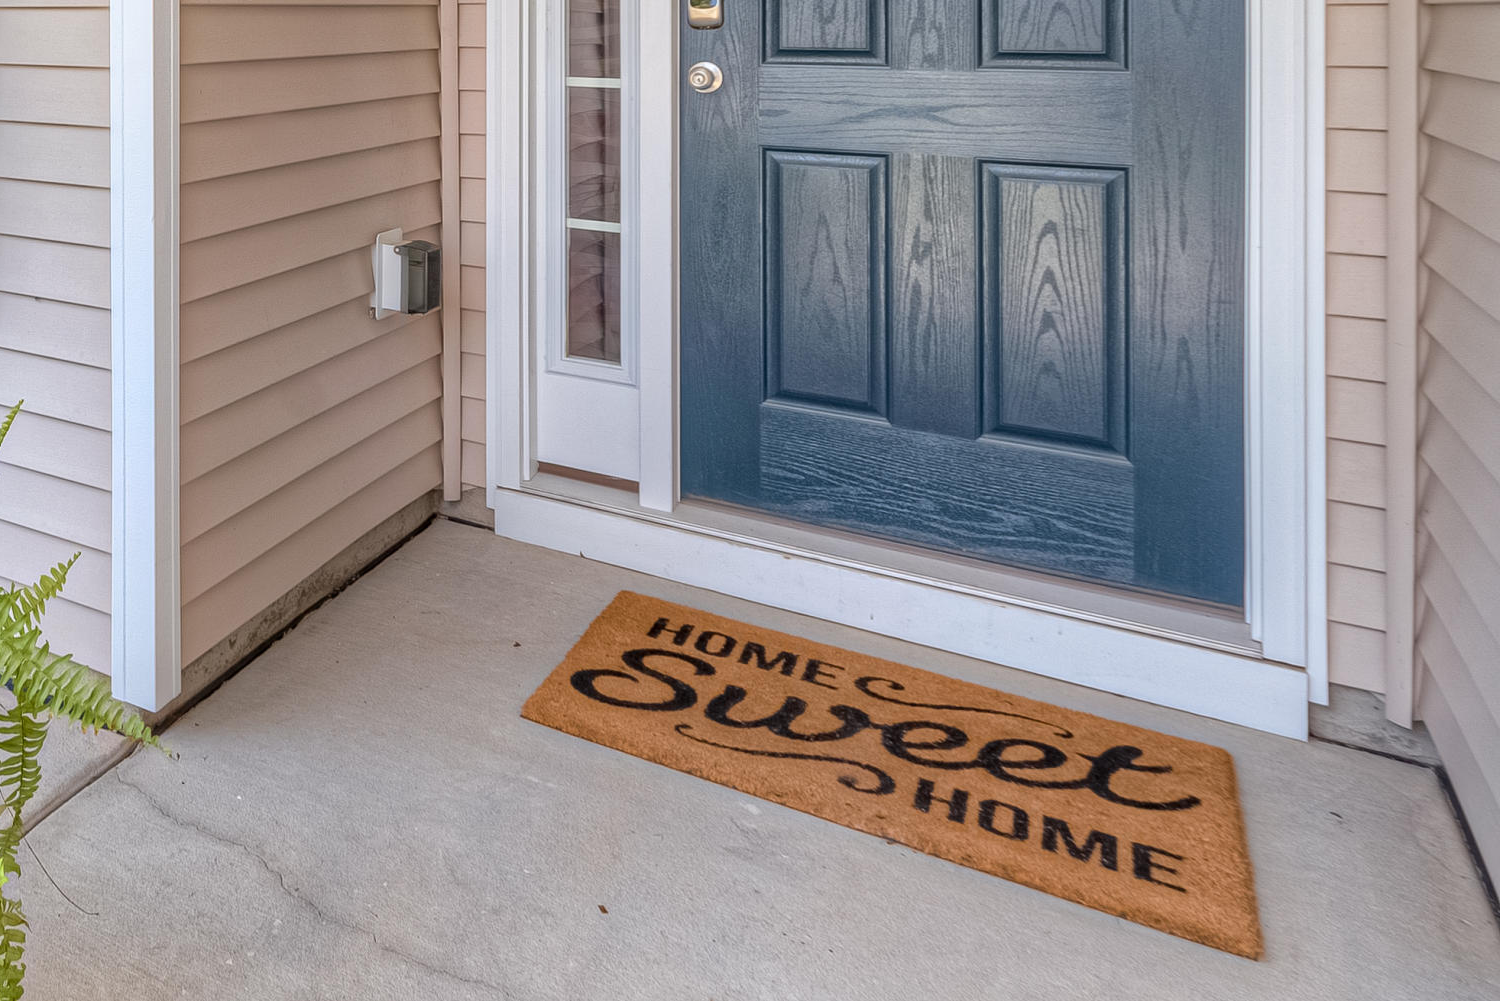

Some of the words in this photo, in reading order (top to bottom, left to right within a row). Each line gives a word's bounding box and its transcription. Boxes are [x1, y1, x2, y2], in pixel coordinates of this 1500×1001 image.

[645, 616, 846, 691] HOME
[568, 647, 1203, 813] Sweet
[912, 776, 1189, 894] HOME
